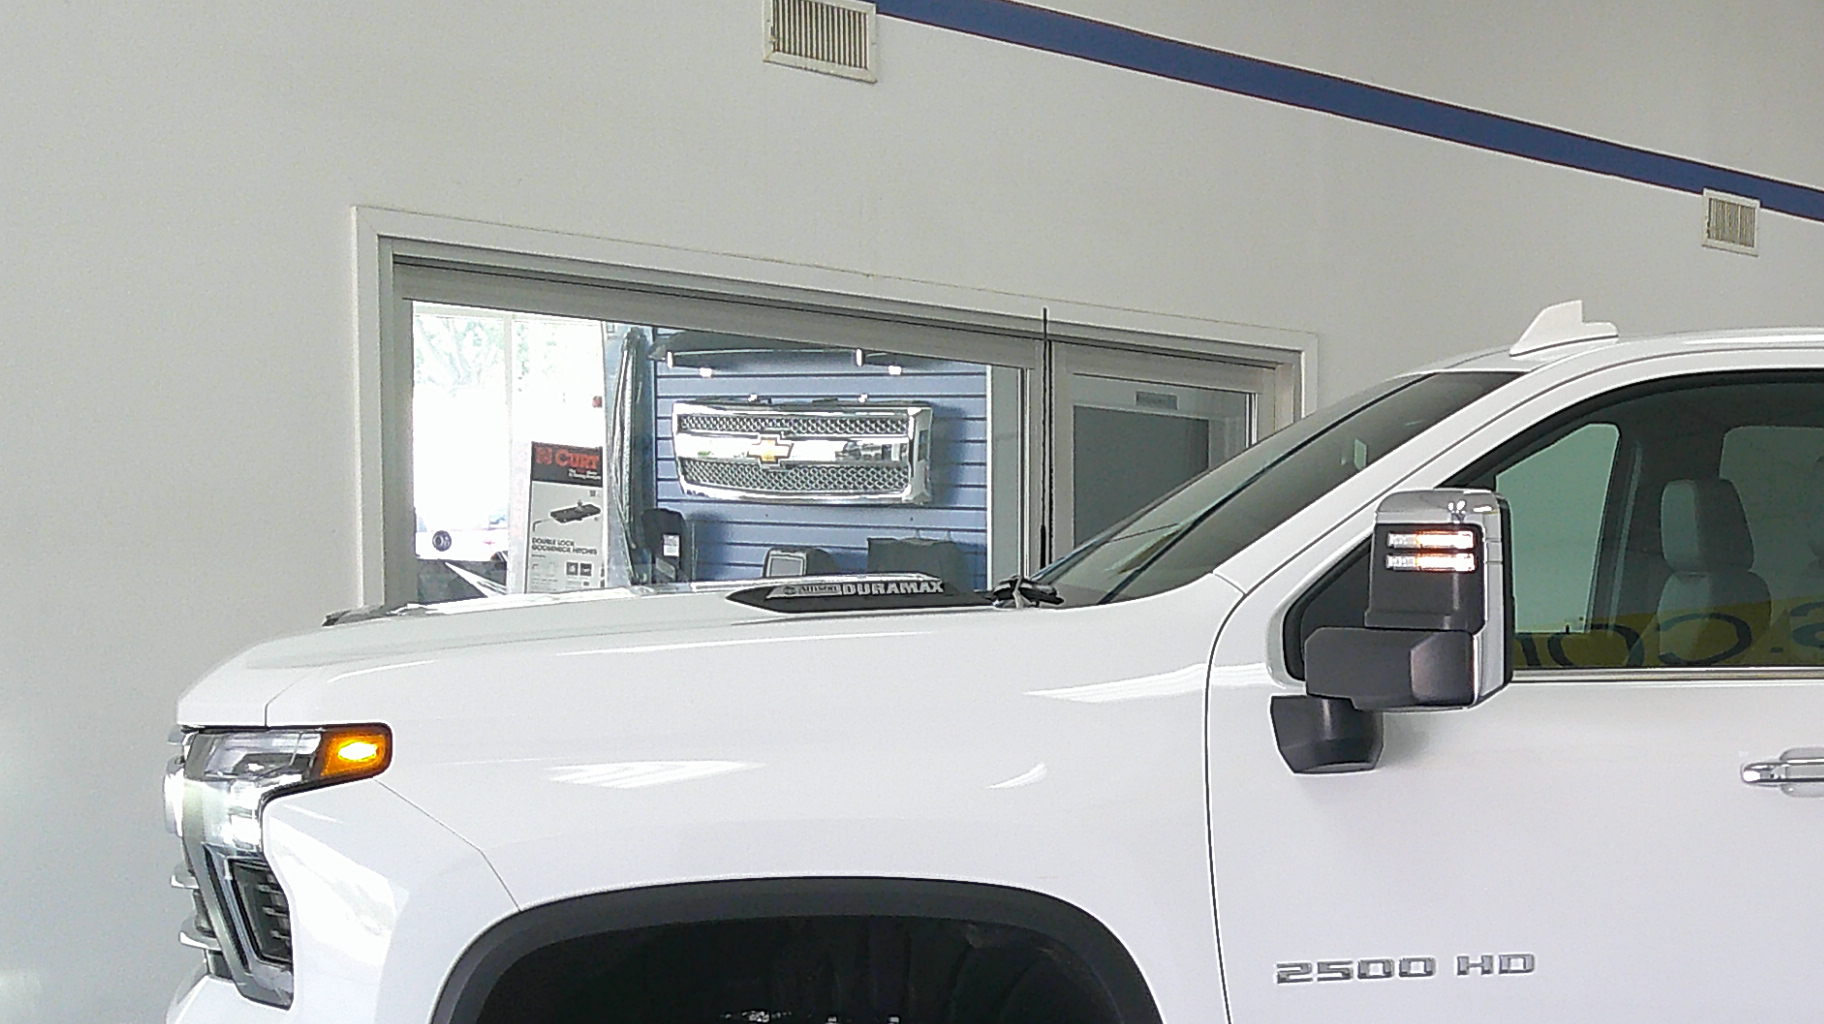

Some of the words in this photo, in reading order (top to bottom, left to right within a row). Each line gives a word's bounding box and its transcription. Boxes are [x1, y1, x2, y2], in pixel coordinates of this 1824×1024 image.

[842, 581, 943, 595] DURAMAX
[1276, 957, 1437, 984] 2500
[1456, 954, 1535, 976] HD
